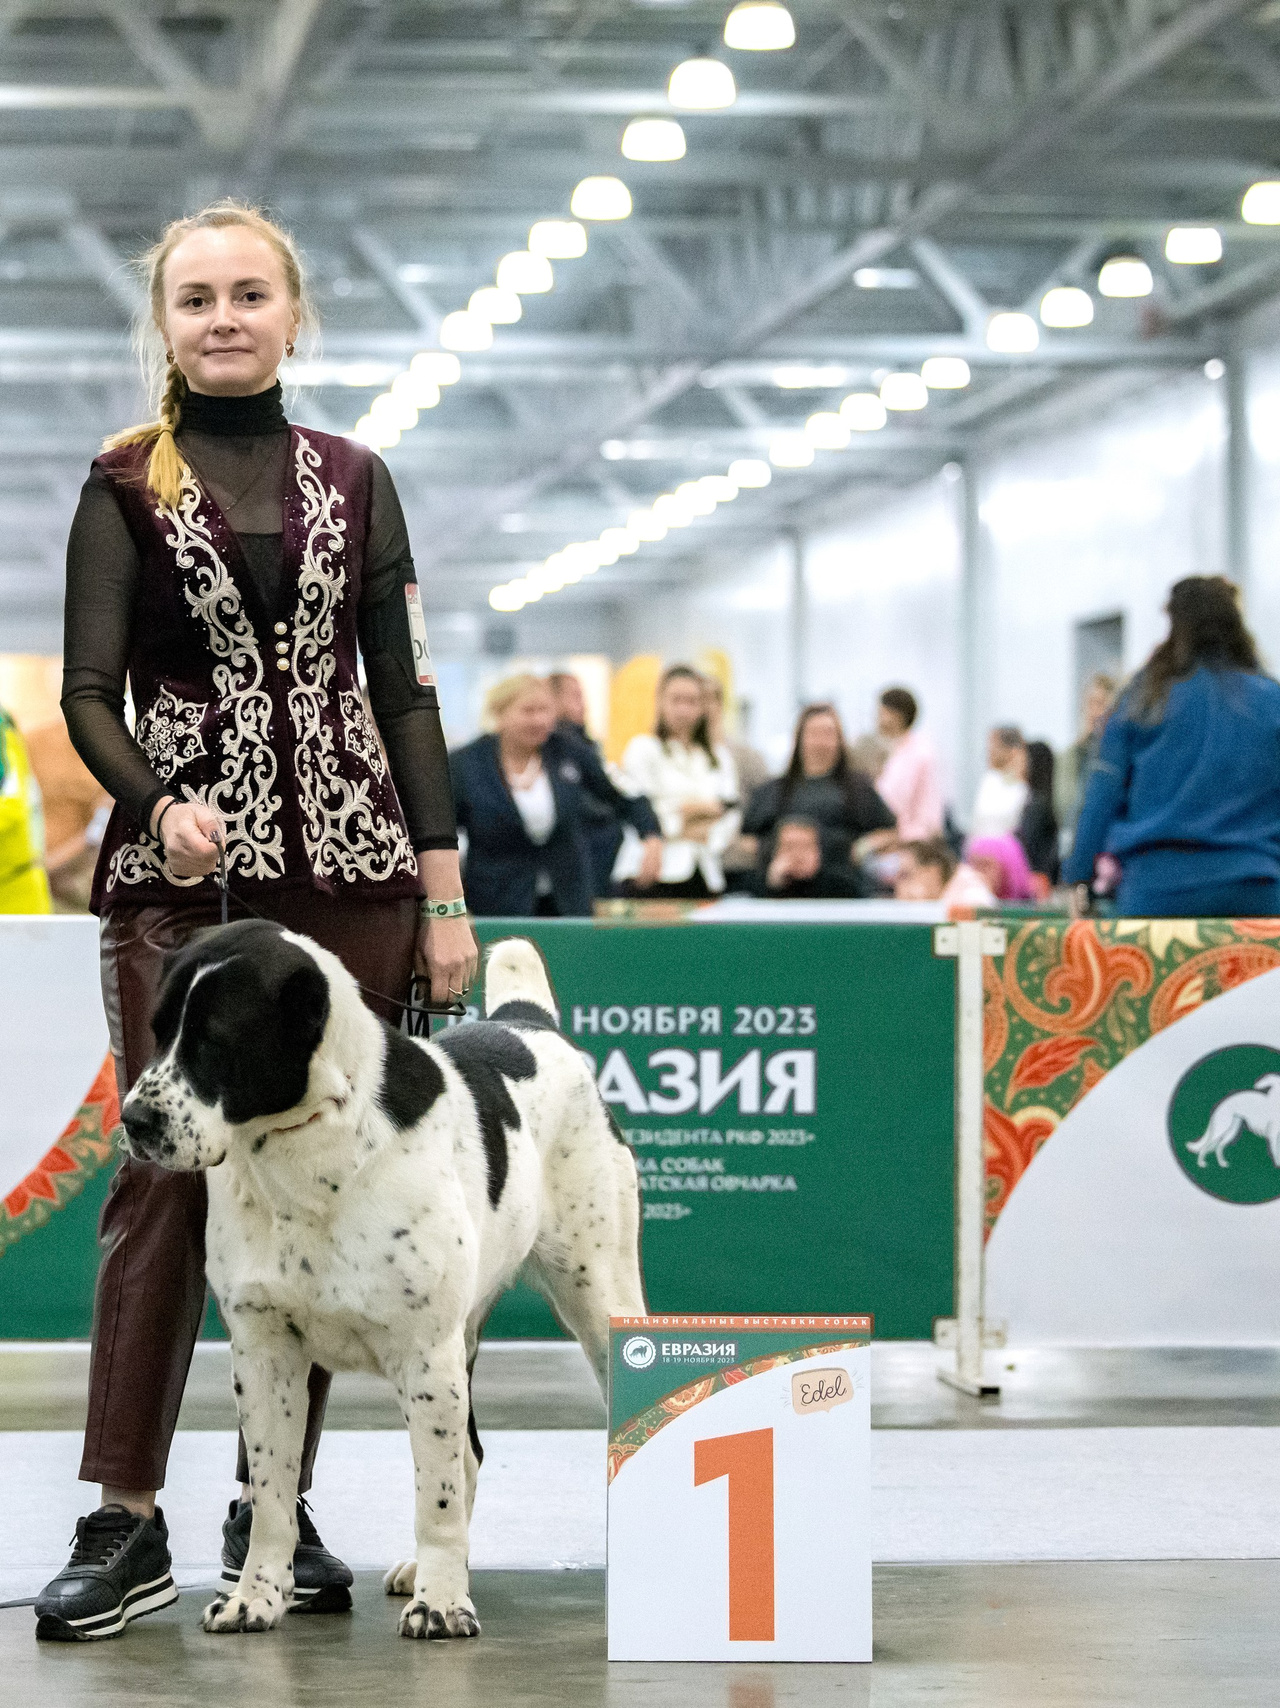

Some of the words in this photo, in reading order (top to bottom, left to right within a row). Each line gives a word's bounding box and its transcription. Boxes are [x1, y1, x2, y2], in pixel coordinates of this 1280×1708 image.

[573, 1006, 722, 1035] НОЯБРЯ
[732, 1006, 818, 1035] 2023
[584, 1048, 817, 1115] АЗИЯ
[660, 1156, 725, 1173] СОБАК
[623, 1317, 735, 1325] НАЦИОНАЛЬНЫЕ
[744, 1317, 816, 1326] ВЫСТАВКИ
[824, 1318, 868, 1326] СОБАК
[661, 1343, 736, 1356] ЕВРАЗИЯ
[802, 1376, 846, 1406] Edel
[693, 1426, 775, 1642] 1
